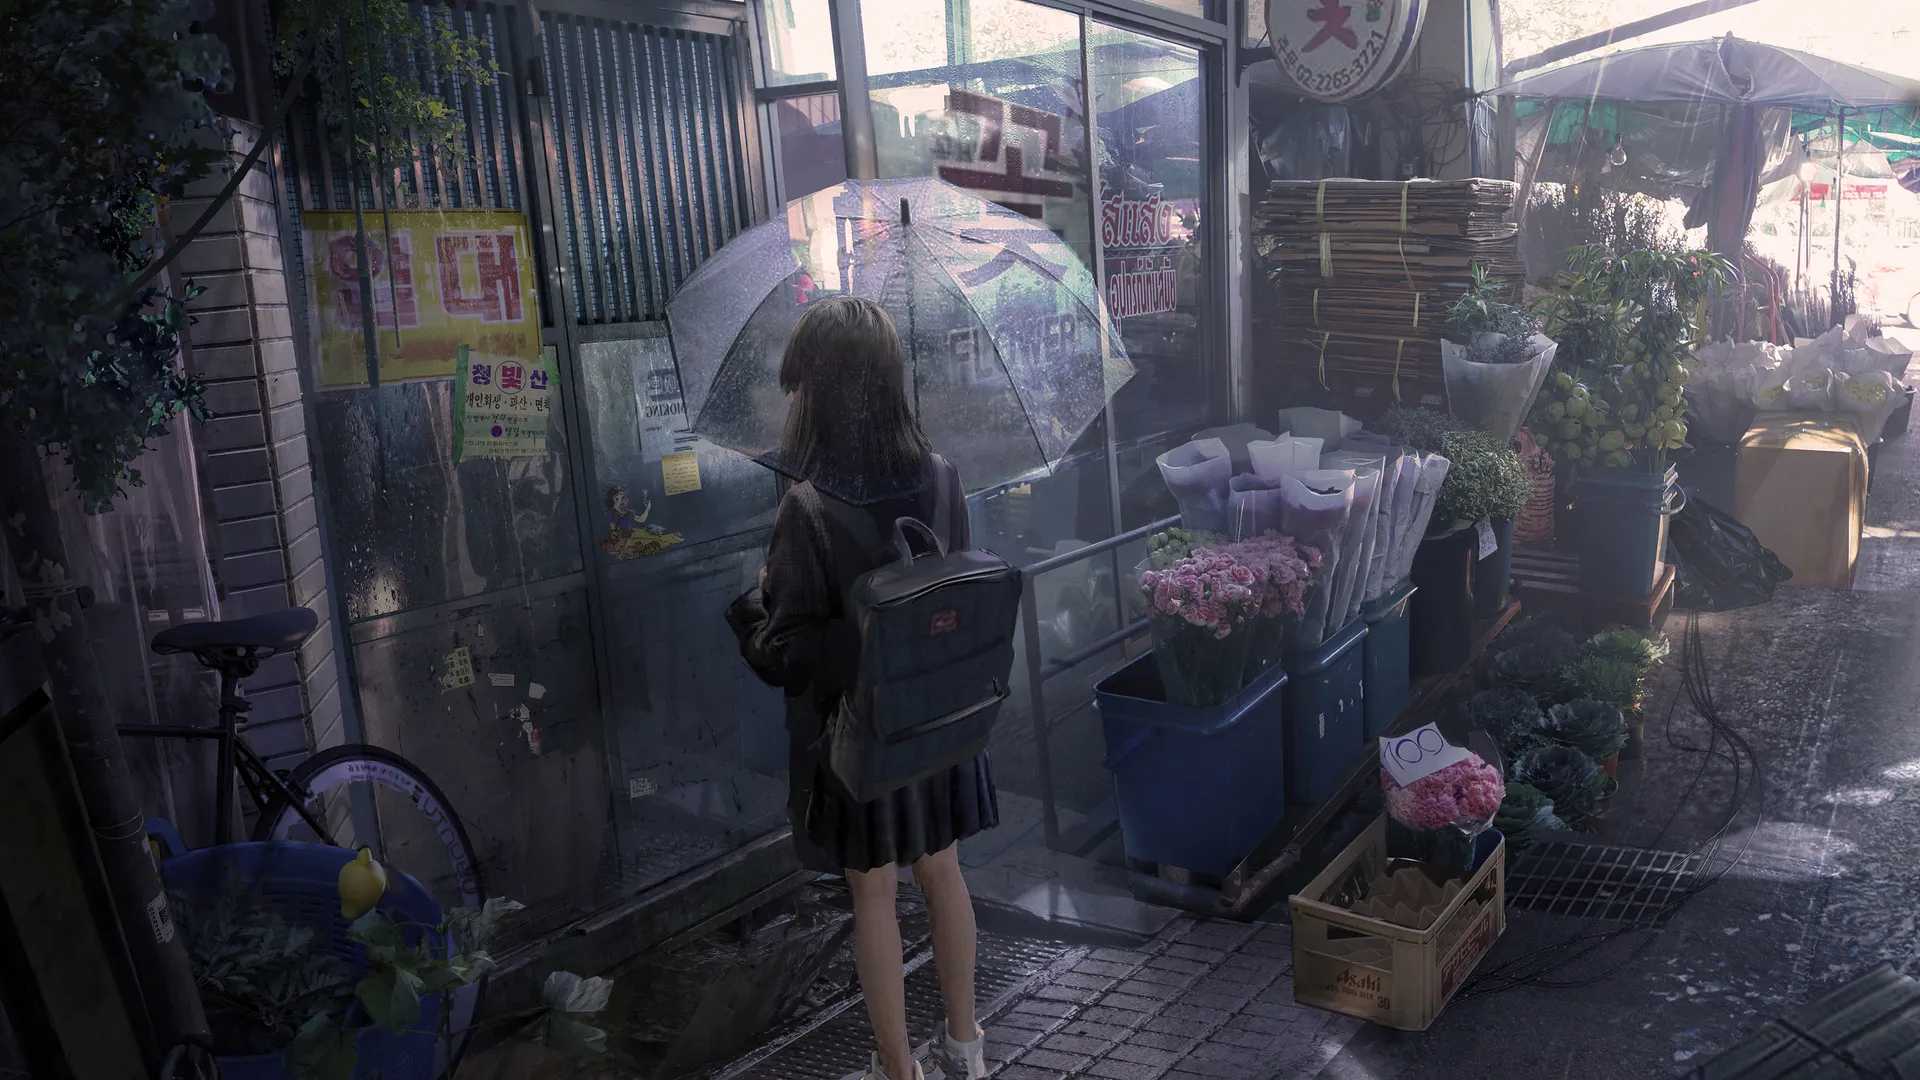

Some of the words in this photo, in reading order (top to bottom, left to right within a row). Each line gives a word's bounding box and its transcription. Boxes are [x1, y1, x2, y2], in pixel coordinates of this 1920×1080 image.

[1295, 30, 1384, 91] 02-2265-3721
[948, 314, 1076, 386] FLOWER
[1383, 728, 1444, 770] 100
[1442, 917, 1489, 984] アサヒビール
[1336, 967, 1381, 993] Asahi
[1377, 995, 1390, 1010] 30
